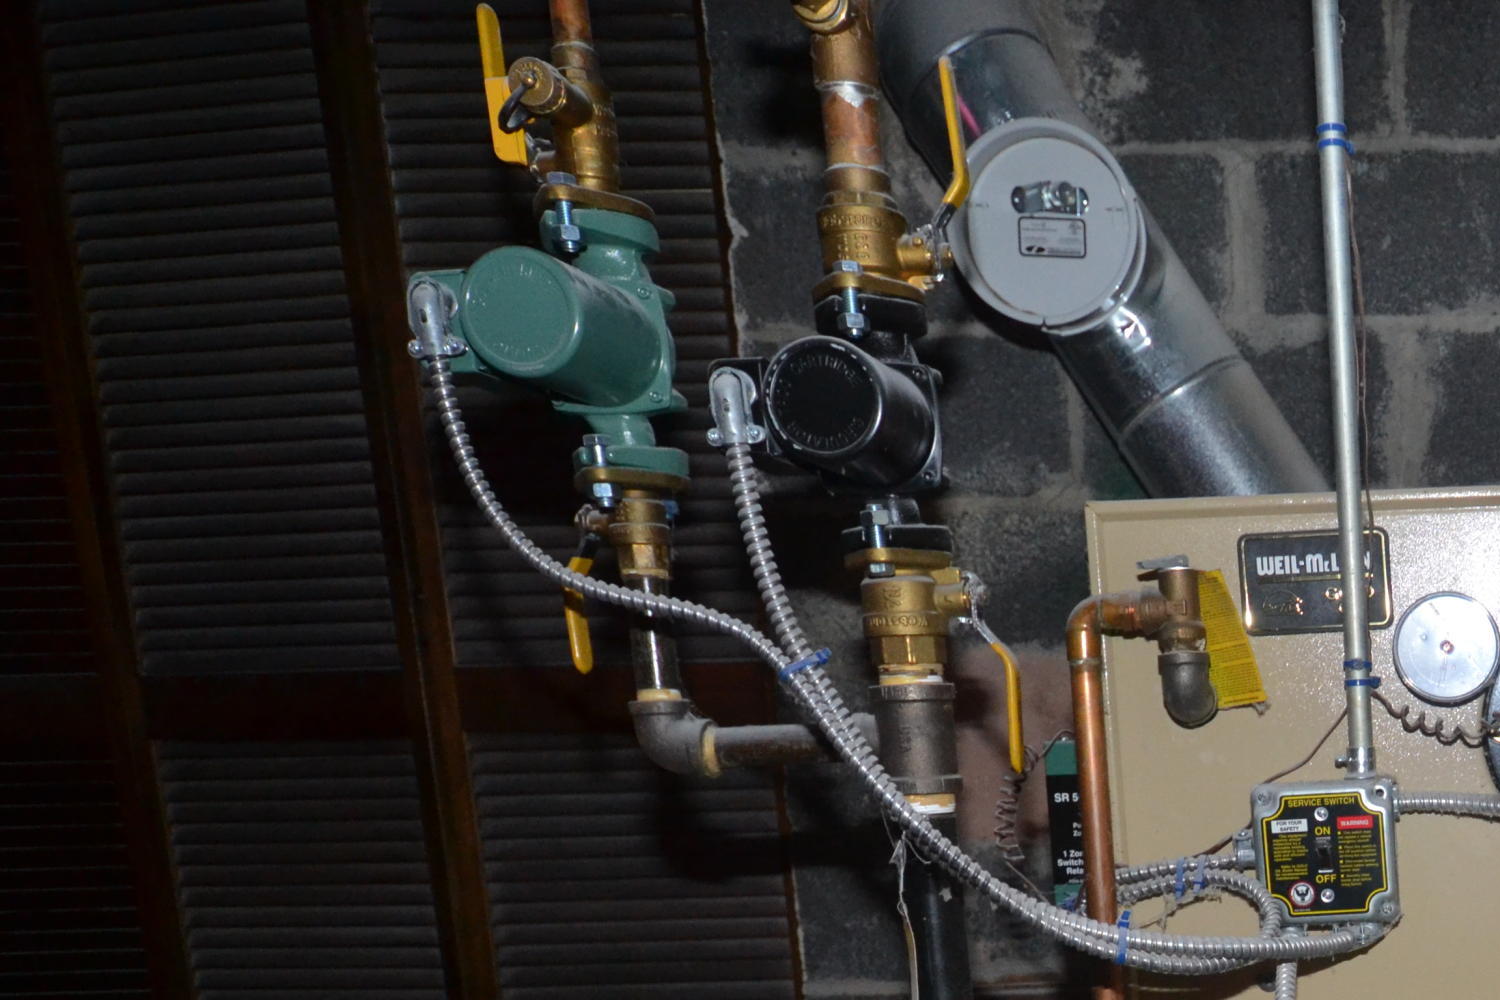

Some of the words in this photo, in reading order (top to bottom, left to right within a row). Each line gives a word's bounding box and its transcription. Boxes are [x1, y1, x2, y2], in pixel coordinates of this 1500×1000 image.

[1256, 551, 1372, 576] WEIL-McLN
[1054, 792, 1070, 803] SR
[1288, 799, 1322, 809] SERVICE
[1324, 796, 1355, 806] SWITCH
[1340, 819, 1369, 827] WARNING
[1314, 826, 1331, 836] ON
[1066, 867, 1084, 875] Rela
[1315, 874, 1337, 884] OFF
